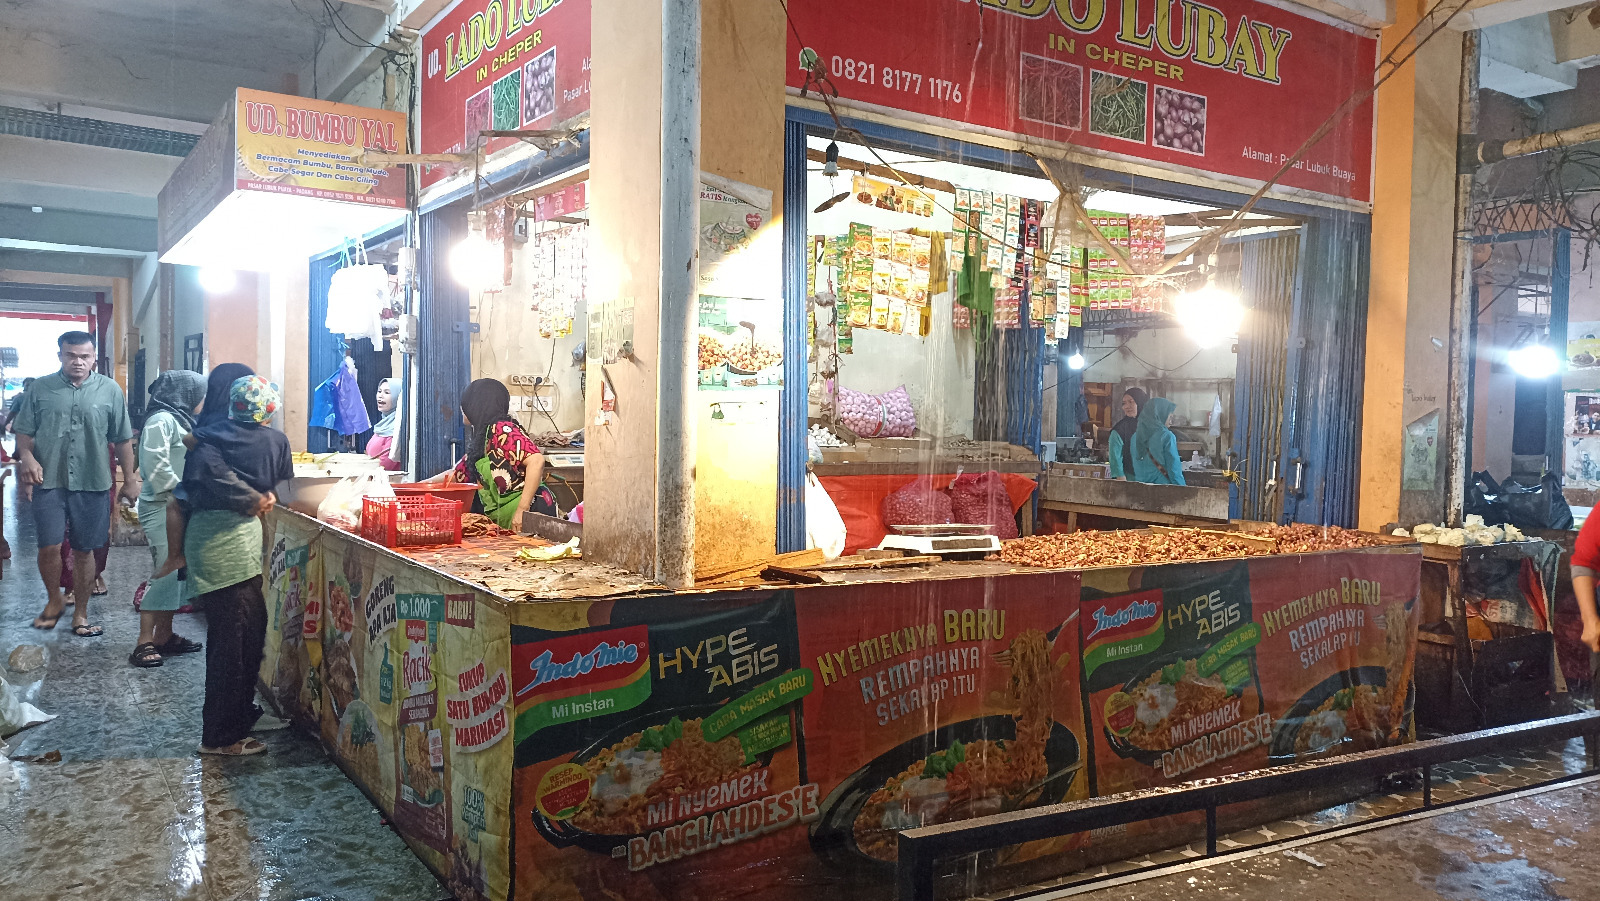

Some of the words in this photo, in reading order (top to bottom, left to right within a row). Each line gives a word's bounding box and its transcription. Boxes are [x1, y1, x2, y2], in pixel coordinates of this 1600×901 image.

[428, 48, 442, 79] UD.
[445, 0, 503, 82] LADO
[475, 64, 488, 83] IN
[491, 29, 543, 73] CHEPER
[1049, 32, 1075, 55] IN
[1086, 43, 1184, 82] CHEPER
[1116, 0, 1292, 85] LUBAY
[563, 84, 583, 104] Pasar
[831, 55, 875, 85] 0821
[882, 67, 922, 95] 8177
[928, 77, 962, 104] 1176
[246, 102, 283, 137] UD.
[286, 107, 358, 147] BUMBU
[360, 118, 399, 152] YAL
[256, 153, 301, 165] Bermacam
[302, 160, 333, 170] Bumbu,
[335, 163, 365, 174] Barang
[297, 148, 350, 161] Menyediakan
[1242, 145, 1273, 164] Alamat
[1280, 153, 1304, 170] Par
[1306, 160, 1331, 175] Lubuk
[1332, 165, 1356, 182] Buaya
[268, 165, 288, 174] Cabe
[291, 168, 315, 179] Segar
[316, 171, 333, 179] Dan
[334, 174, 354, 182] Cabe
[356, 176, 379, 187] Giling
[700, 191, 723, 201] RATIS
[365, 574, 395, 619] GORENG
[409, 597, 431, 618] 1.000
[447, 600, 472, 620] BARU!
[1167, 589, 1226, 630] HYPE
[1262, 587, 1339, 637] NYEMEKNYA
[1340, 577, 1381, 606] BARU
[368, 615, 382, 646] APA
[382, 603, 397, 628] AJA
[1086, 599, 1157, 641] Indomie
[1195, 602, 1241, 640] ABIS
[1288, 608, 1365, 652] REMPAHNYA
[658, 627, 757, 680] HYPE
[816, 622, 938, 687] NYEMEKNYA
[943, 609, 1006, 643] BARU
[1106, 646, 1117, 658] Mi
[1118, 643, 1143, 655] Instan
[1217, 636, 1239, 657] MASAK
[1240, 627, 1257, 642] BARU
[1299, 632, 1347, 670] SEKALAP
[402, 646, 433, 690] Racik
[458, 662, 485, 692] CUKUP
[516, 640, 639, 697] Indomie
[704, 643, 779, 694] ABIS
[859, 646, 981, 705] REMPAHNYA
[952, 673, 975, 697] ITU
[447, 699, 470, 720] SATU
[471, 672, 507, 717] BUMBU
[551, 705, 569, 719] Mi
[571, 696, 615, 716] Instan
[709, 709, 737, 735] CARA
[739, 687, 776, 714] MASAK
[778, 674, 807, 696] BARU
[455, 708, 506, 747] MARINASI
[1170, 722, 1187, 743] MI
[1187, 700, 1241, 735] NYEMEK
[543, 773, 583, 793] WARMINDO
[549, 767, 574, 783] RESEP
[646, 796, 674, 826] MI
[678, 768, 769, 818] NYEMEK
